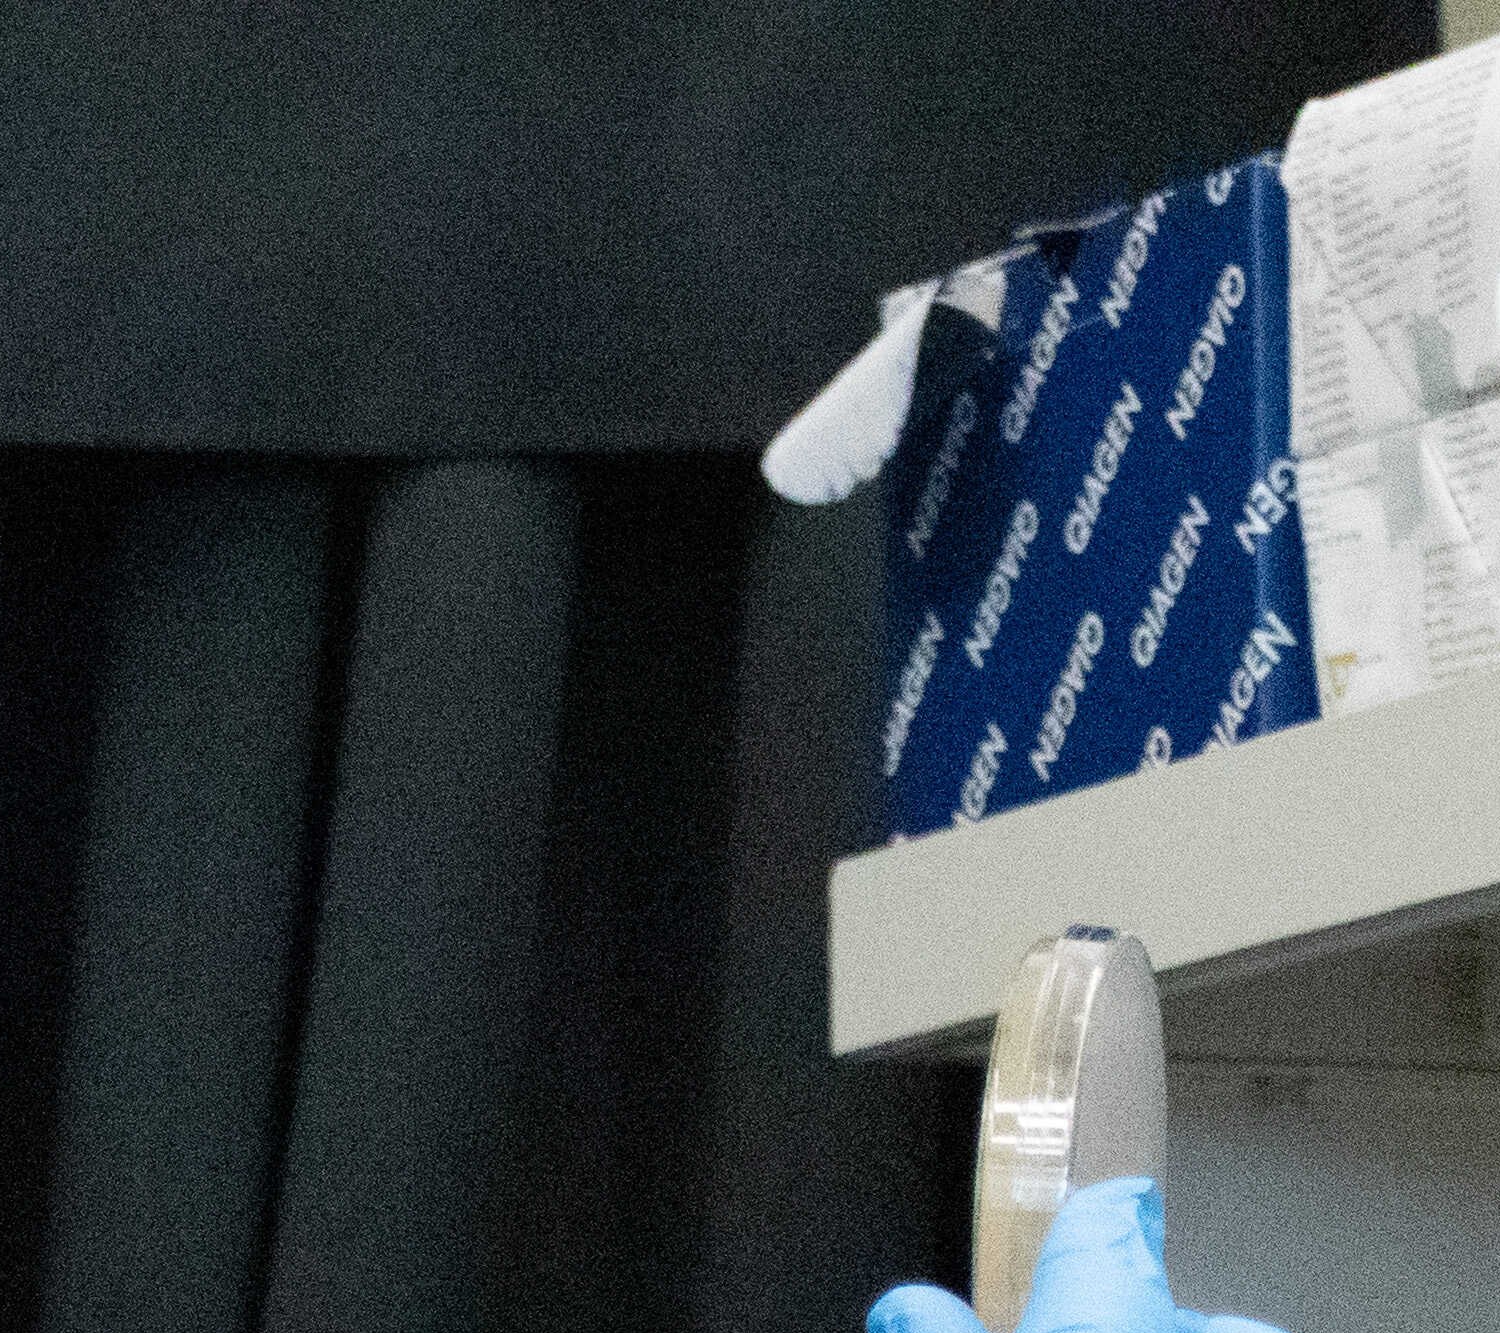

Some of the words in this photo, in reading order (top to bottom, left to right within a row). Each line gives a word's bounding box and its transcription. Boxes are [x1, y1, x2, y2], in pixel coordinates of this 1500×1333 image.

[1102, 191, 1168, 328] IAGEN
[999, 275, 1080, 445] QIAGEN
[1165, 264, 1246, 439] QIAGEN
[1064, 382, 1142, 554] QIAGEN
[1234, 457, 1300, 554] GEN
[965, 500, 1038, 668] QIAGEN
[1131, 495, 1210, 669] QIAGEN
[1029, 611, 1104, 782] QIAGEN
[1203, 609, 1299, 754] IAGEN
[955, 722, 1007, 826] GEN
